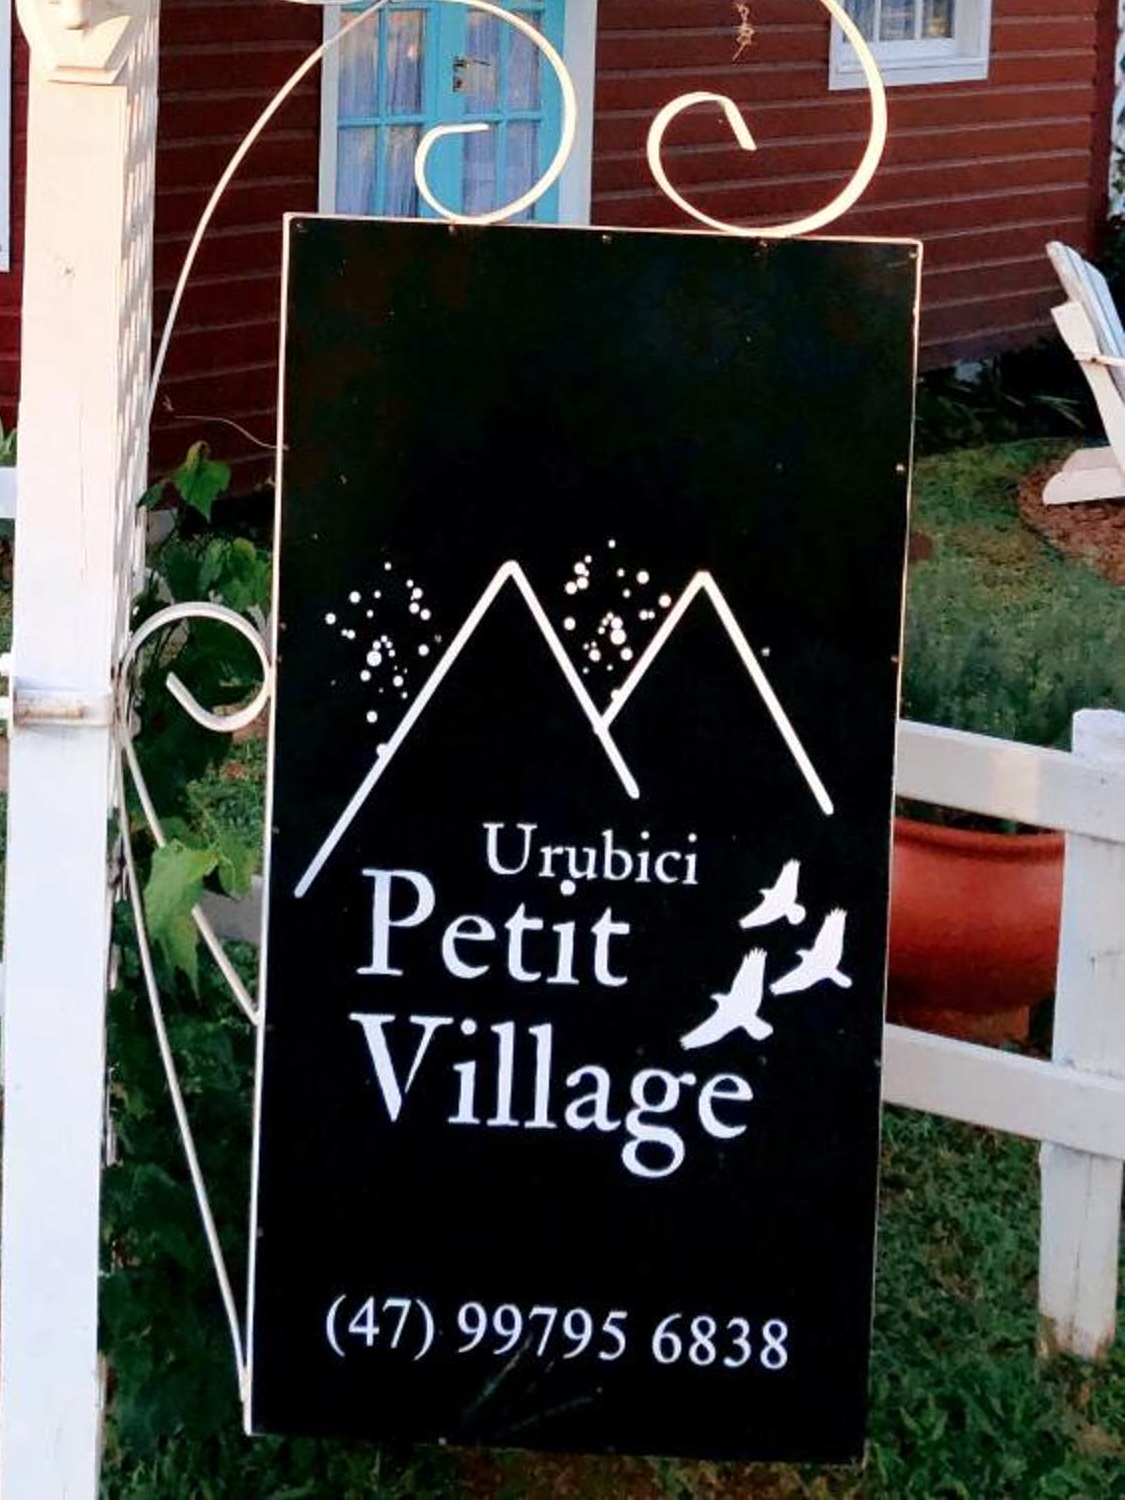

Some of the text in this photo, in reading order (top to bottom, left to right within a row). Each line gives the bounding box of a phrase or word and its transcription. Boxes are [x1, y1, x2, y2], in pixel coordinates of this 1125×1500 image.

[482, 822, 699, 886] Urubici
[356, 868, 631, 988] Petit
[349, 1012, 754, 1178] Village
[325, 1294, 789, 1370] (47) 99795 6838
